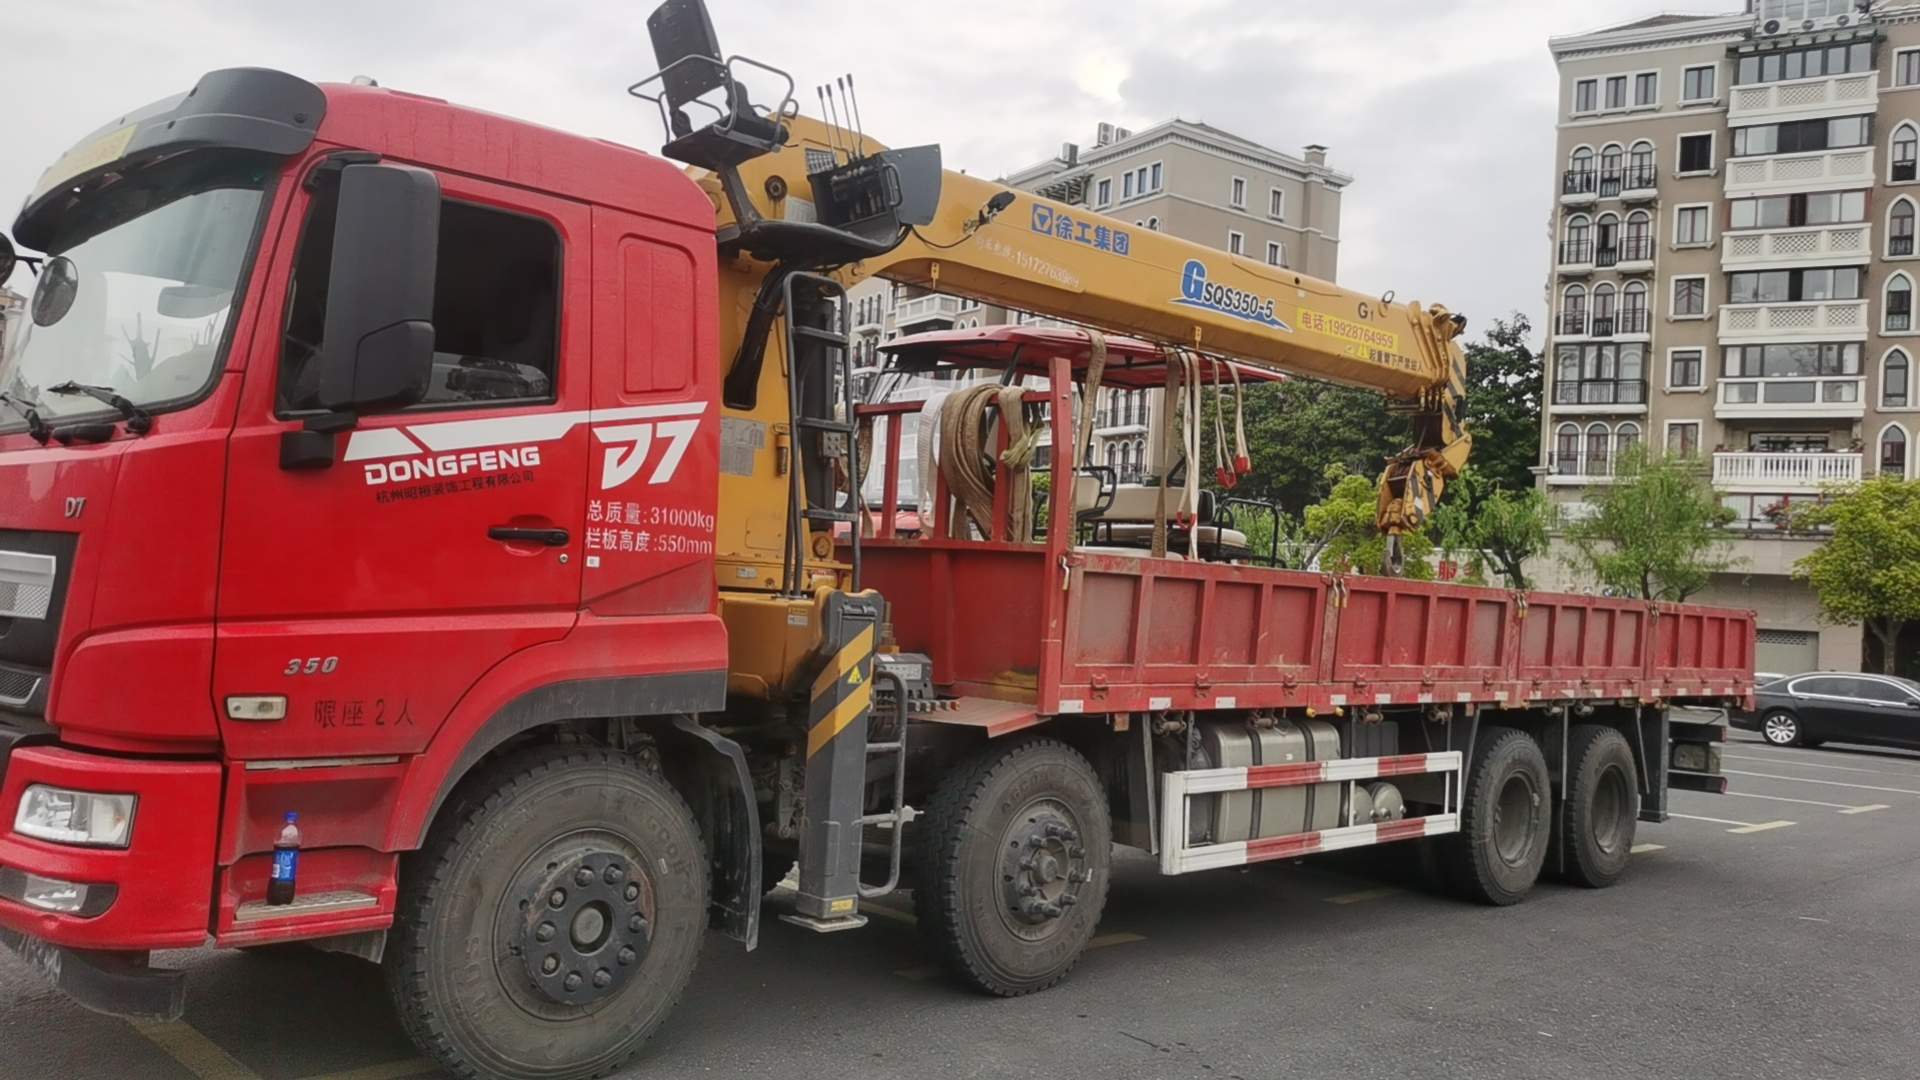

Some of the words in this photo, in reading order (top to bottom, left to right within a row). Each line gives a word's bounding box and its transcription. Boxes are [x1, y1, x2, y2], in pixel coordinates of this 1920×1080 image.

[1055, 214, 1129, 256] 徐工集团
[364, 446, 540, 485] DONGFENG
[593, 419, 700, 490] D7
[65, 497, 86, 518] D7
[587, 500, 714, 532] 总质量:31000kg
[585, 528, 712, 554] 栏板高度:550mm
[284, 656, 339, 675] 350
